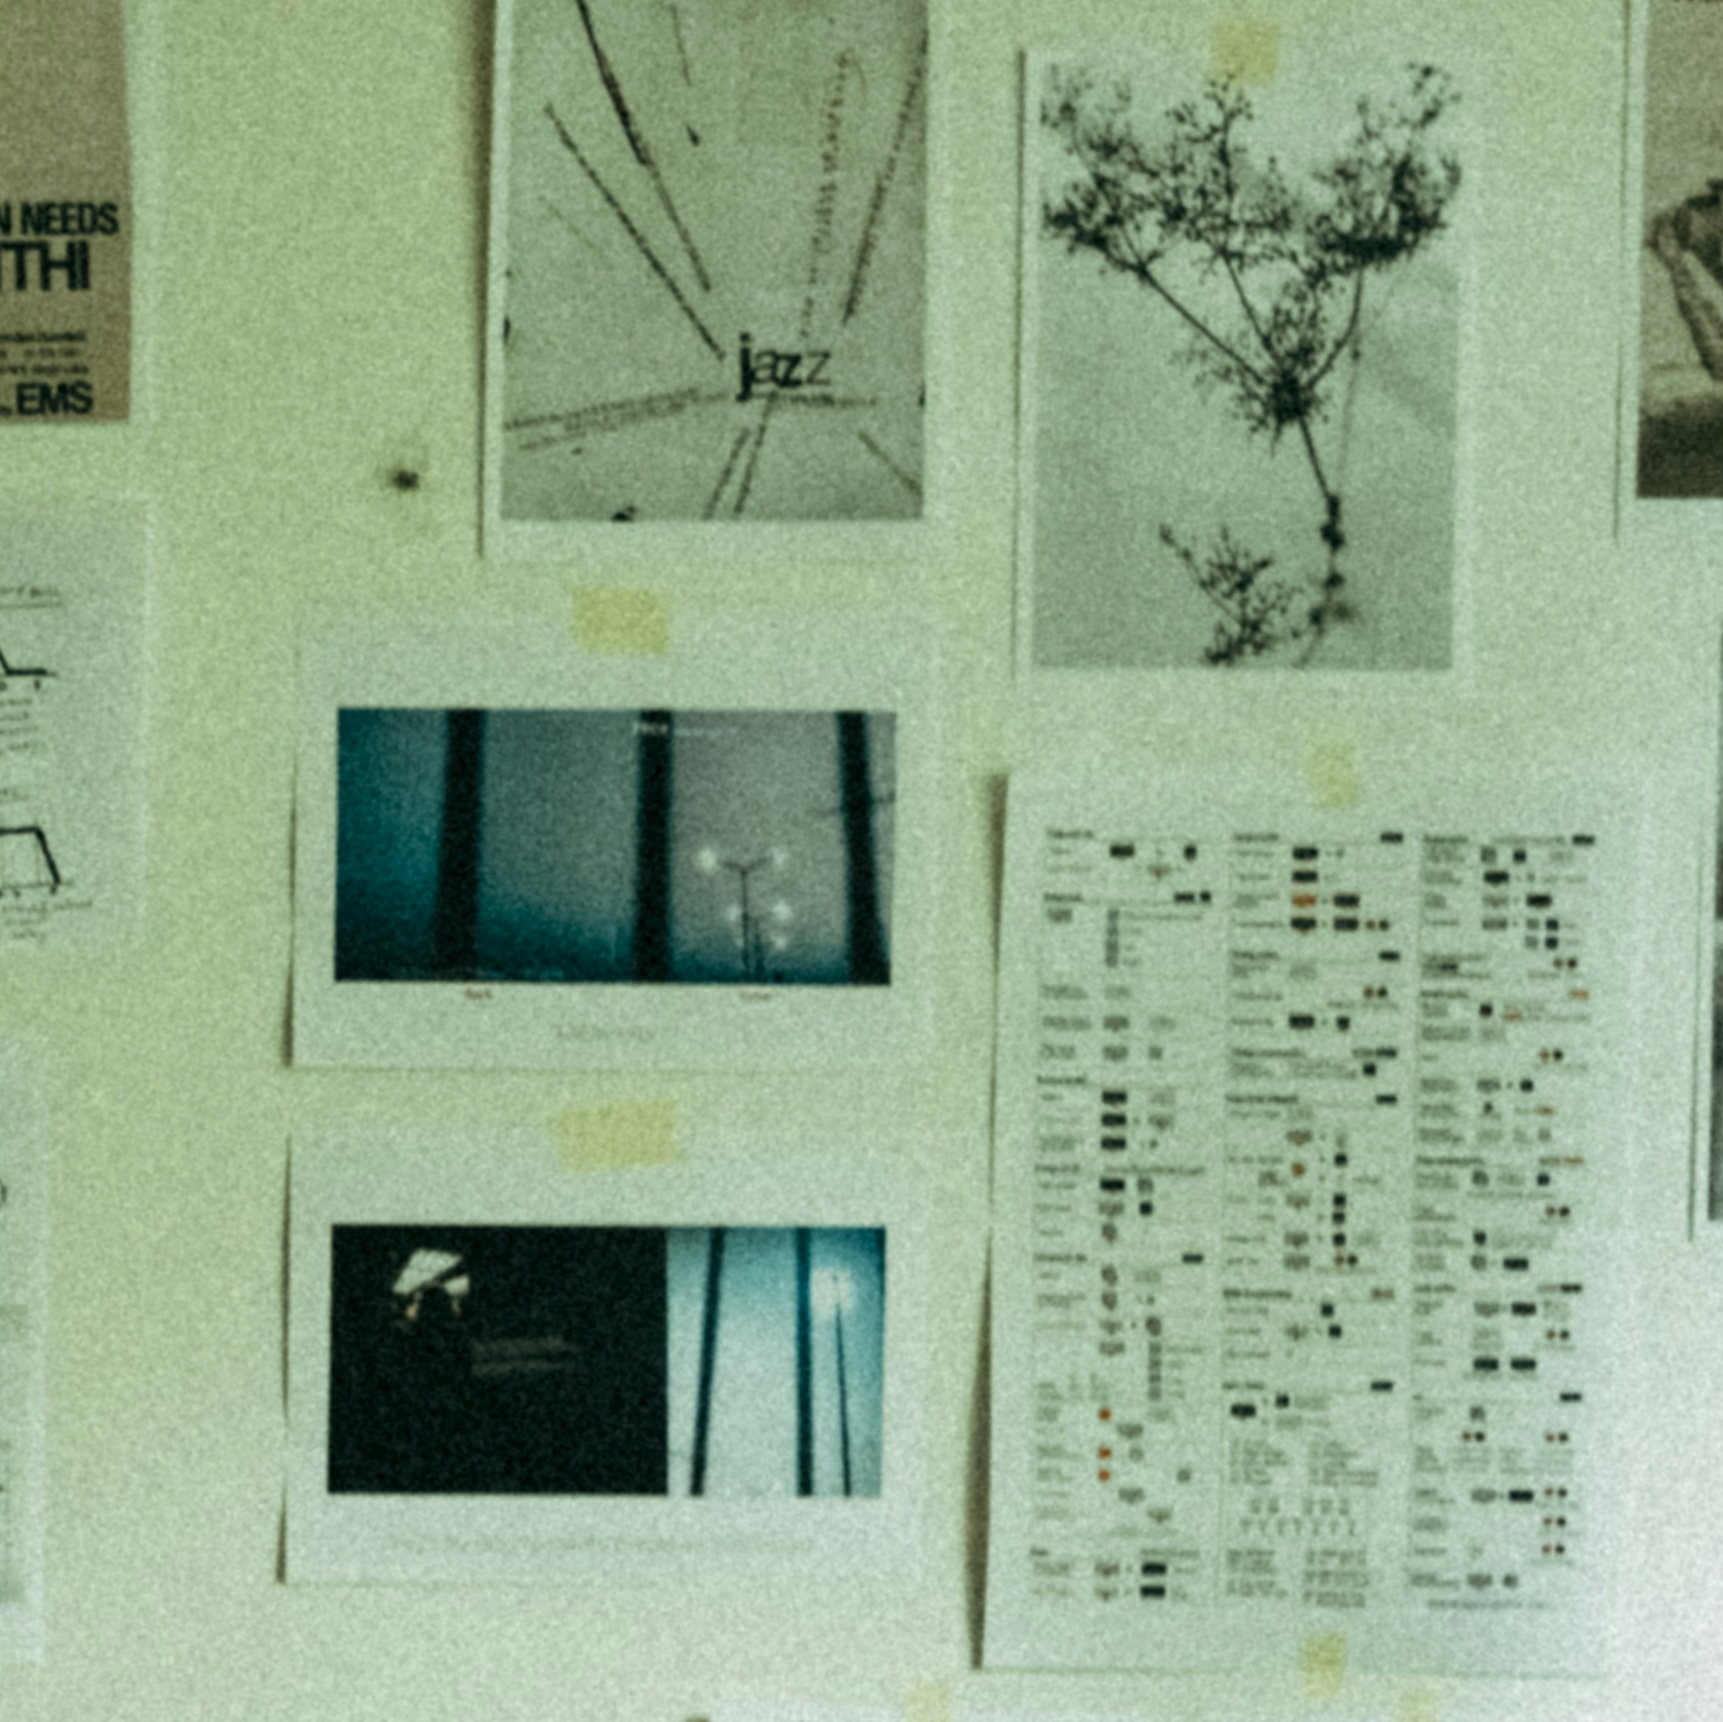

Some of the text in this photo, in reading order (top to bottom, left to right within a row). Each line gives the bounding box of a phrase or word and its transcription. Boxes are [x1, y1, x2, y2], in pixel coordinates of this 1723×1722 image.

[20, 201, 120, 237] NEEDS
[735, 331, 832, 402] jazz
[15, 380, 94, 417] EMS
